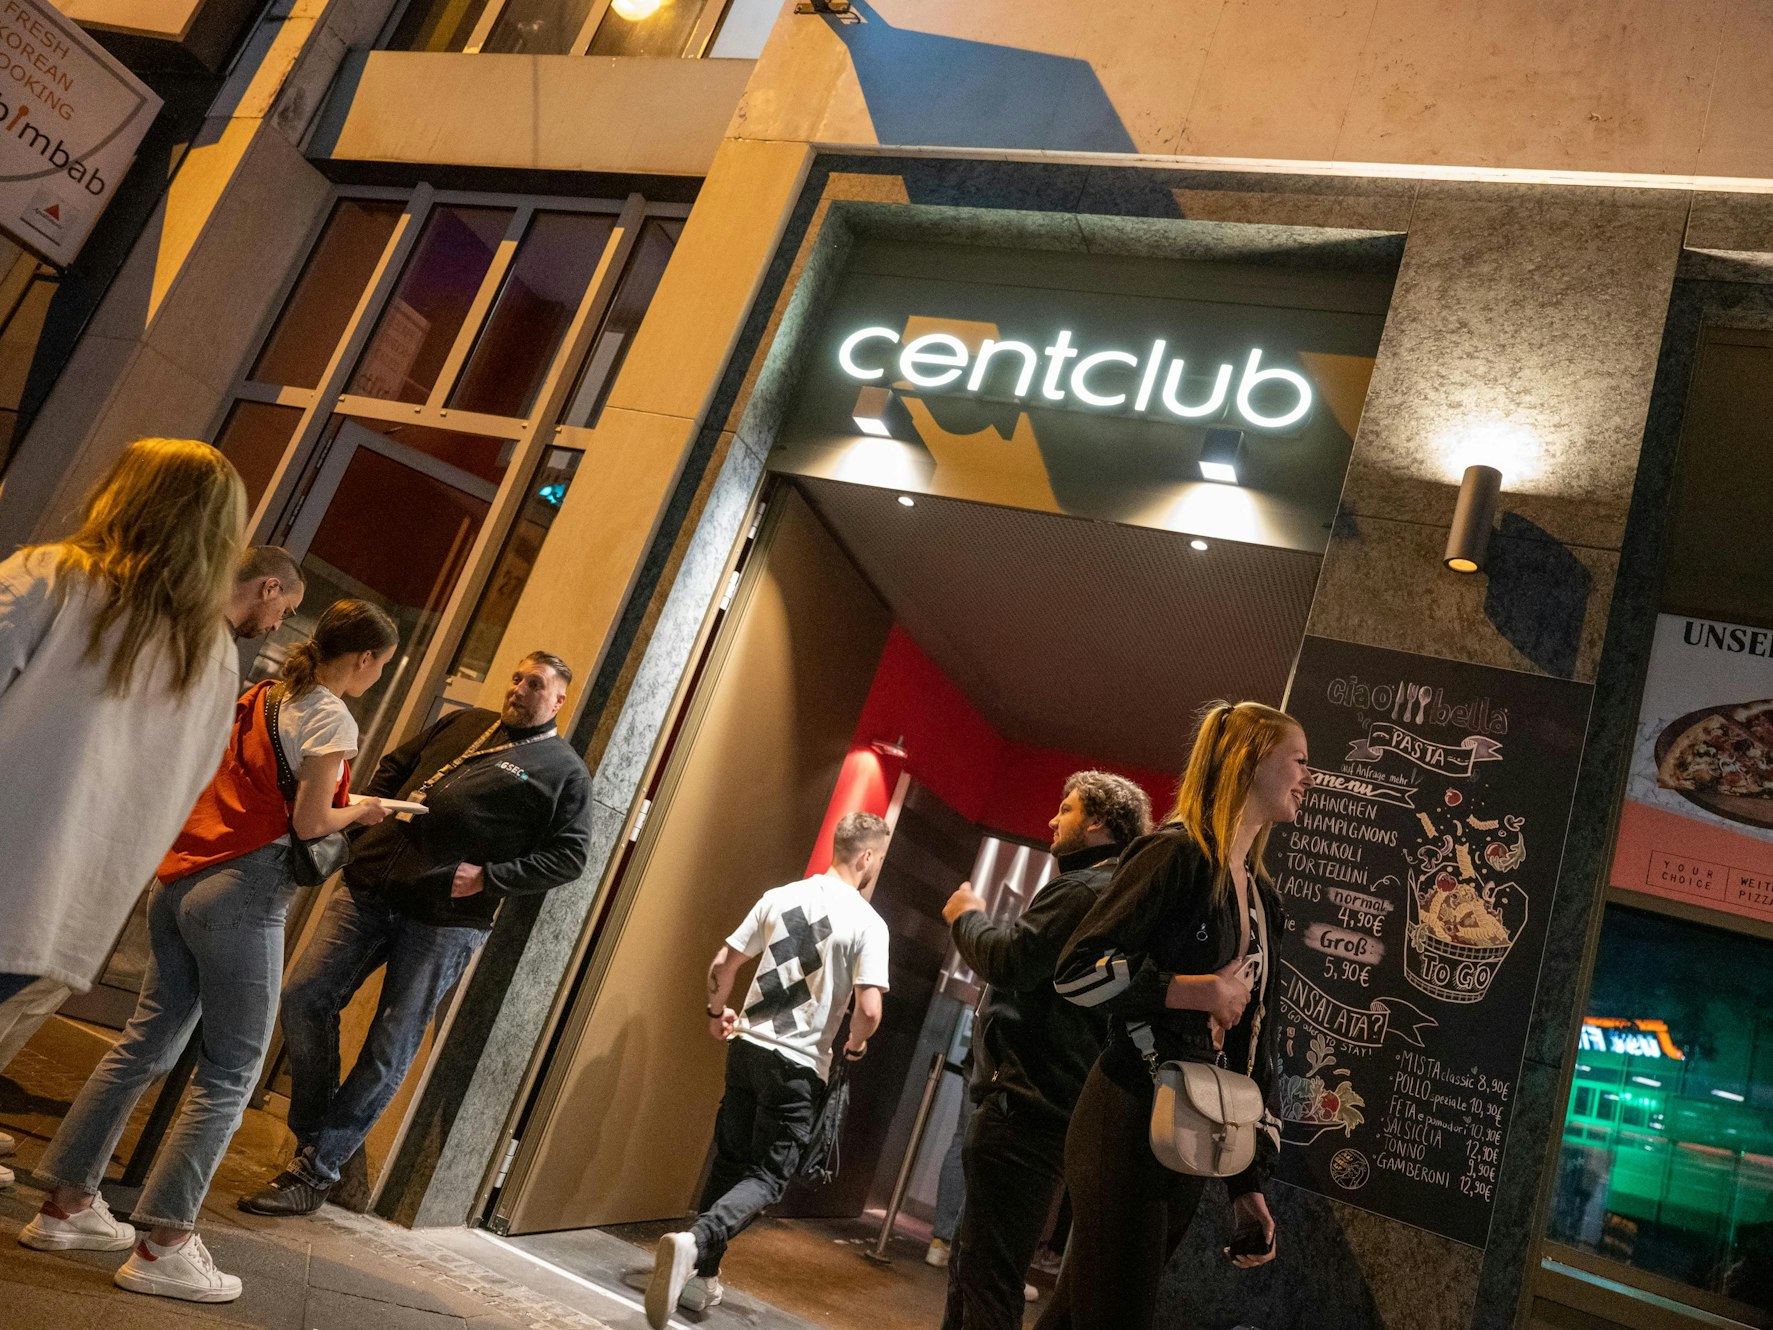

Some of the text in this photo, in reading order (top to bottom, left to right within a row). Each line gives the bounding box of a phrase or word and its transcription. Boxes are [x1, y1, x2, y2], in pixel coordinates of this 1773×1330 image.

[4, 0, 70, 60] FRESH
[838, 326, 1313, 428] centclub
[1429, 688, 1507, 735] bella
[1392, 730, 1445, 767] PASTA
[1356, 764, 1385, 781] Anfrage
[1390, 774, 1408, 785] mehr
[1277, 873, 1321, 902] LACHS
[1662, 871, 1712, 891] CHOICE
[1664, 861, 1713, 879] YOUR
[1338, 907, 1385, 936] 4,90€
[1323, 956, 1371, 987] 5,90€
[1422, 952, 1491, 989] TO GO
[1288, 1010, 1301, 1023] GO
[1326, 1036, 1336, 1047] TO
[1400, 1050, 1510, 1100] MISTA classic 8,90€
[1389, 1095, 1416, 1119] FETA
[1417, 1113, 1424, 1121] e
[1426, 1115, 1468, 1135] pomodori
[1394, 1071, 1431, 1100] POLLO
[1470, 1097, 1503, 1127] 10,90€
[1383, 1117, 1499, 1164] SALSICCIA 12,90€
[1384, 1134, 1495, 1182] TONNO 9,90€
[1377, 1152, 1493, 1202] GAMBERONI 12,90€
